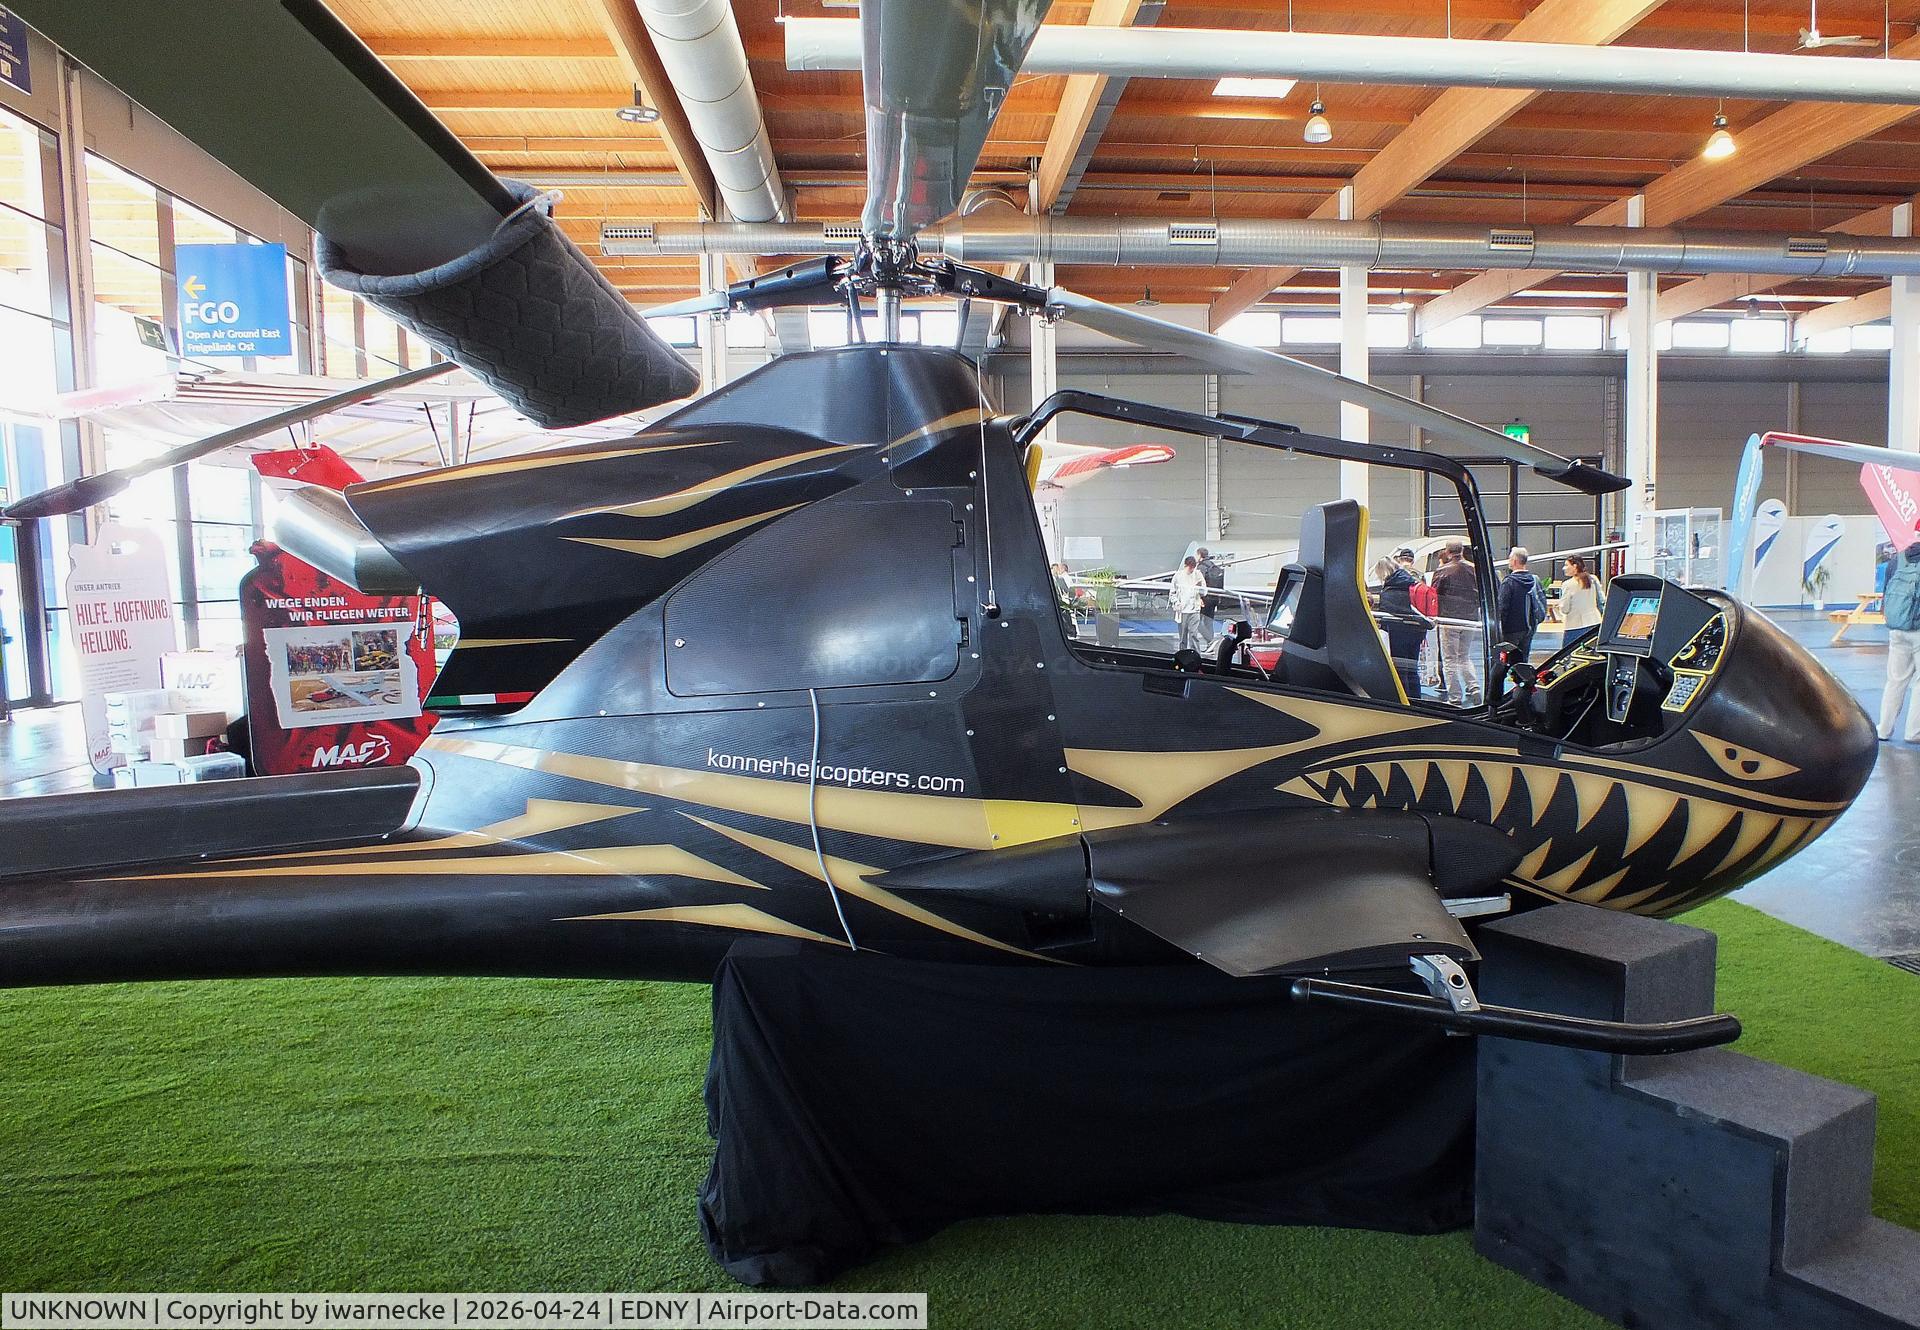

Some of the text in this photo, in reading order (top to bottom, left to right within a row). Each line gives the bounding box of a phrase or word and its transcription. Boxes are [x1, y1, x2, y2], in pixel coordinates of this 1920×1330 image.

[184, 301, 240, 325] FGO
[186, 328, 281, 341] Open Air Ground East
[187, 342, 256, 354] Freigelände Ost
[74, 583, 121, 592] UNSER ANTRIEB
[266, 597, 348, 609] WEGE ENDEN.
[75, 599, 171, 626] HILFE. HOFFNUNG.
[289, 608, 412, 622] WIR FLIEGEN WEITER.
[80, 629, 132, 654] HEILUNG.
[312, 741, 377, 768] MAF
